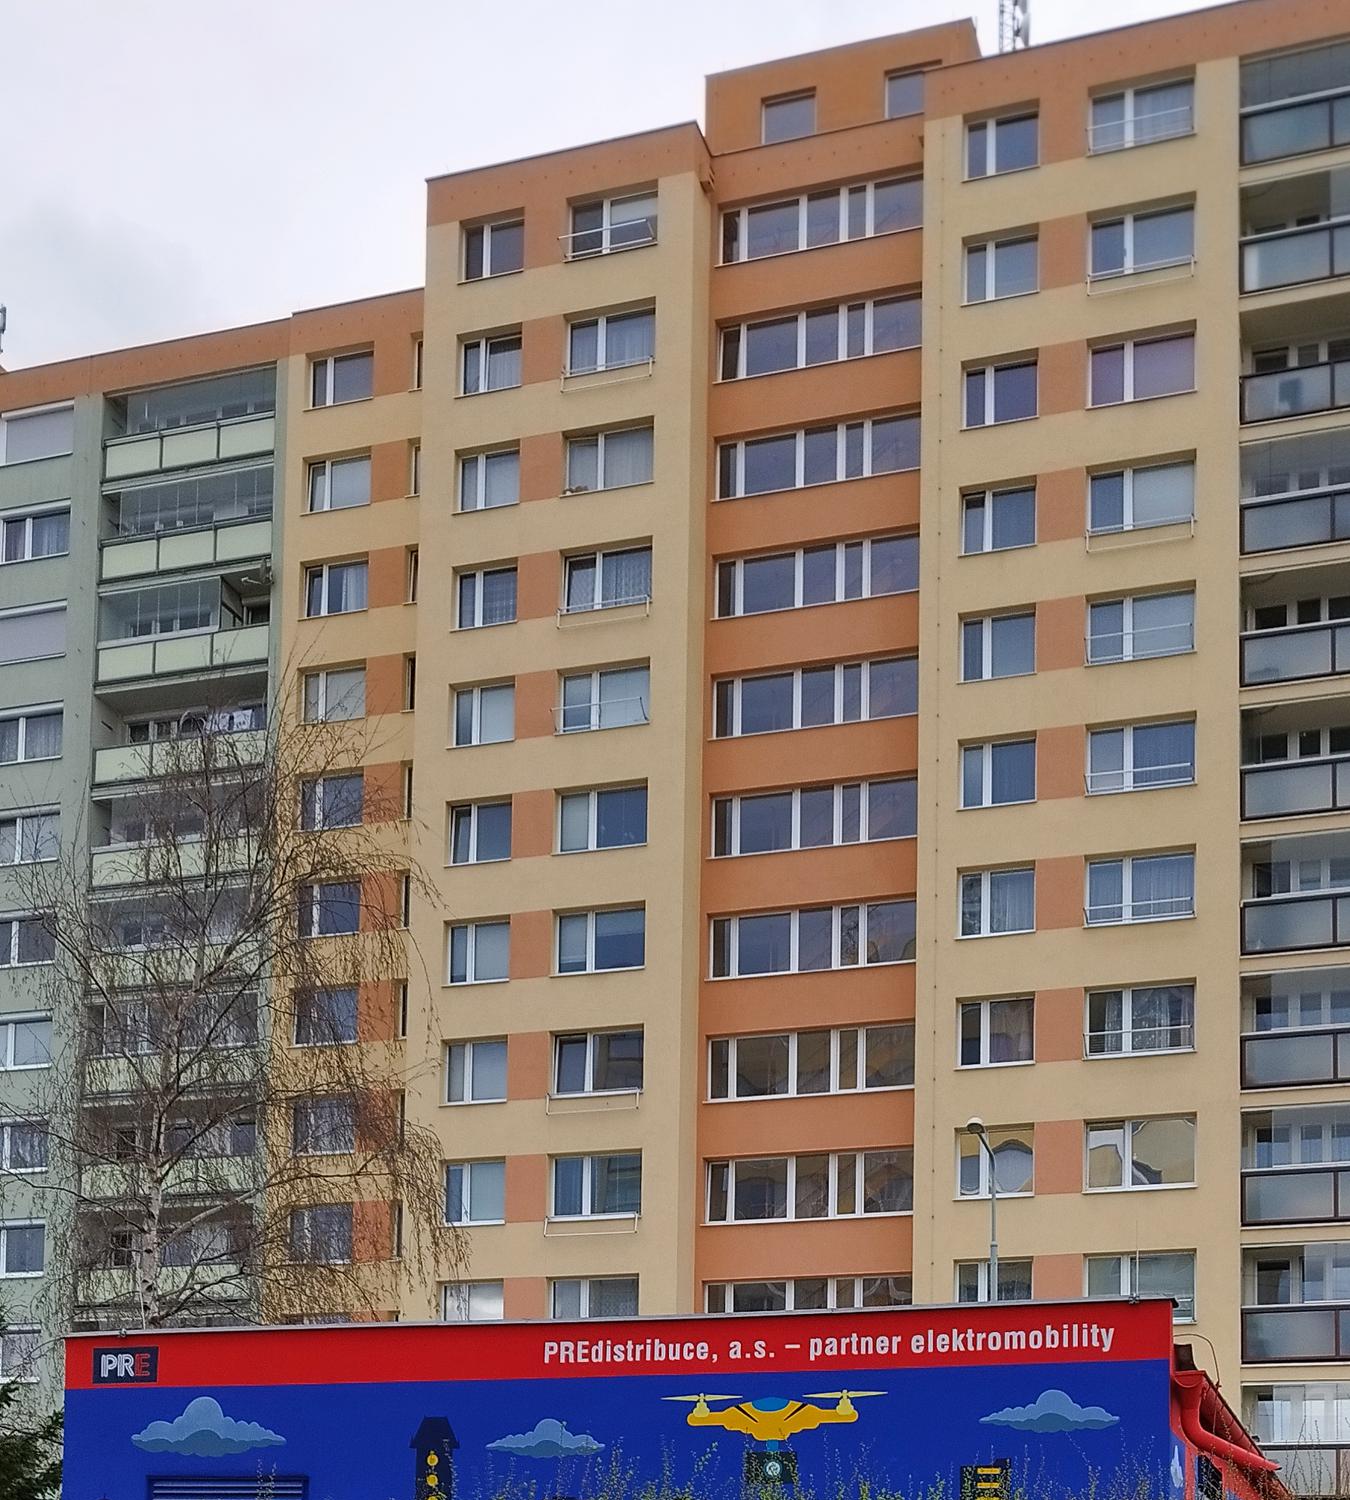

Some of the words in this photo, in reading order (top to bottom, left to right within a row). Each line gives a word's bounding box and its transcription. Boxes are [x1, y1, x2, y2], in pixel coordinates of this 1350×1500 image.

[544, 1338, 719, 1364] PREdistribuce,
[729, 1340, 776, 1360] a.s.
[809, 1332, 902, 1361] partner
[910, 1323, 1116, 1355] elektromobility
[100, 1353, 151, 1378] PRE
